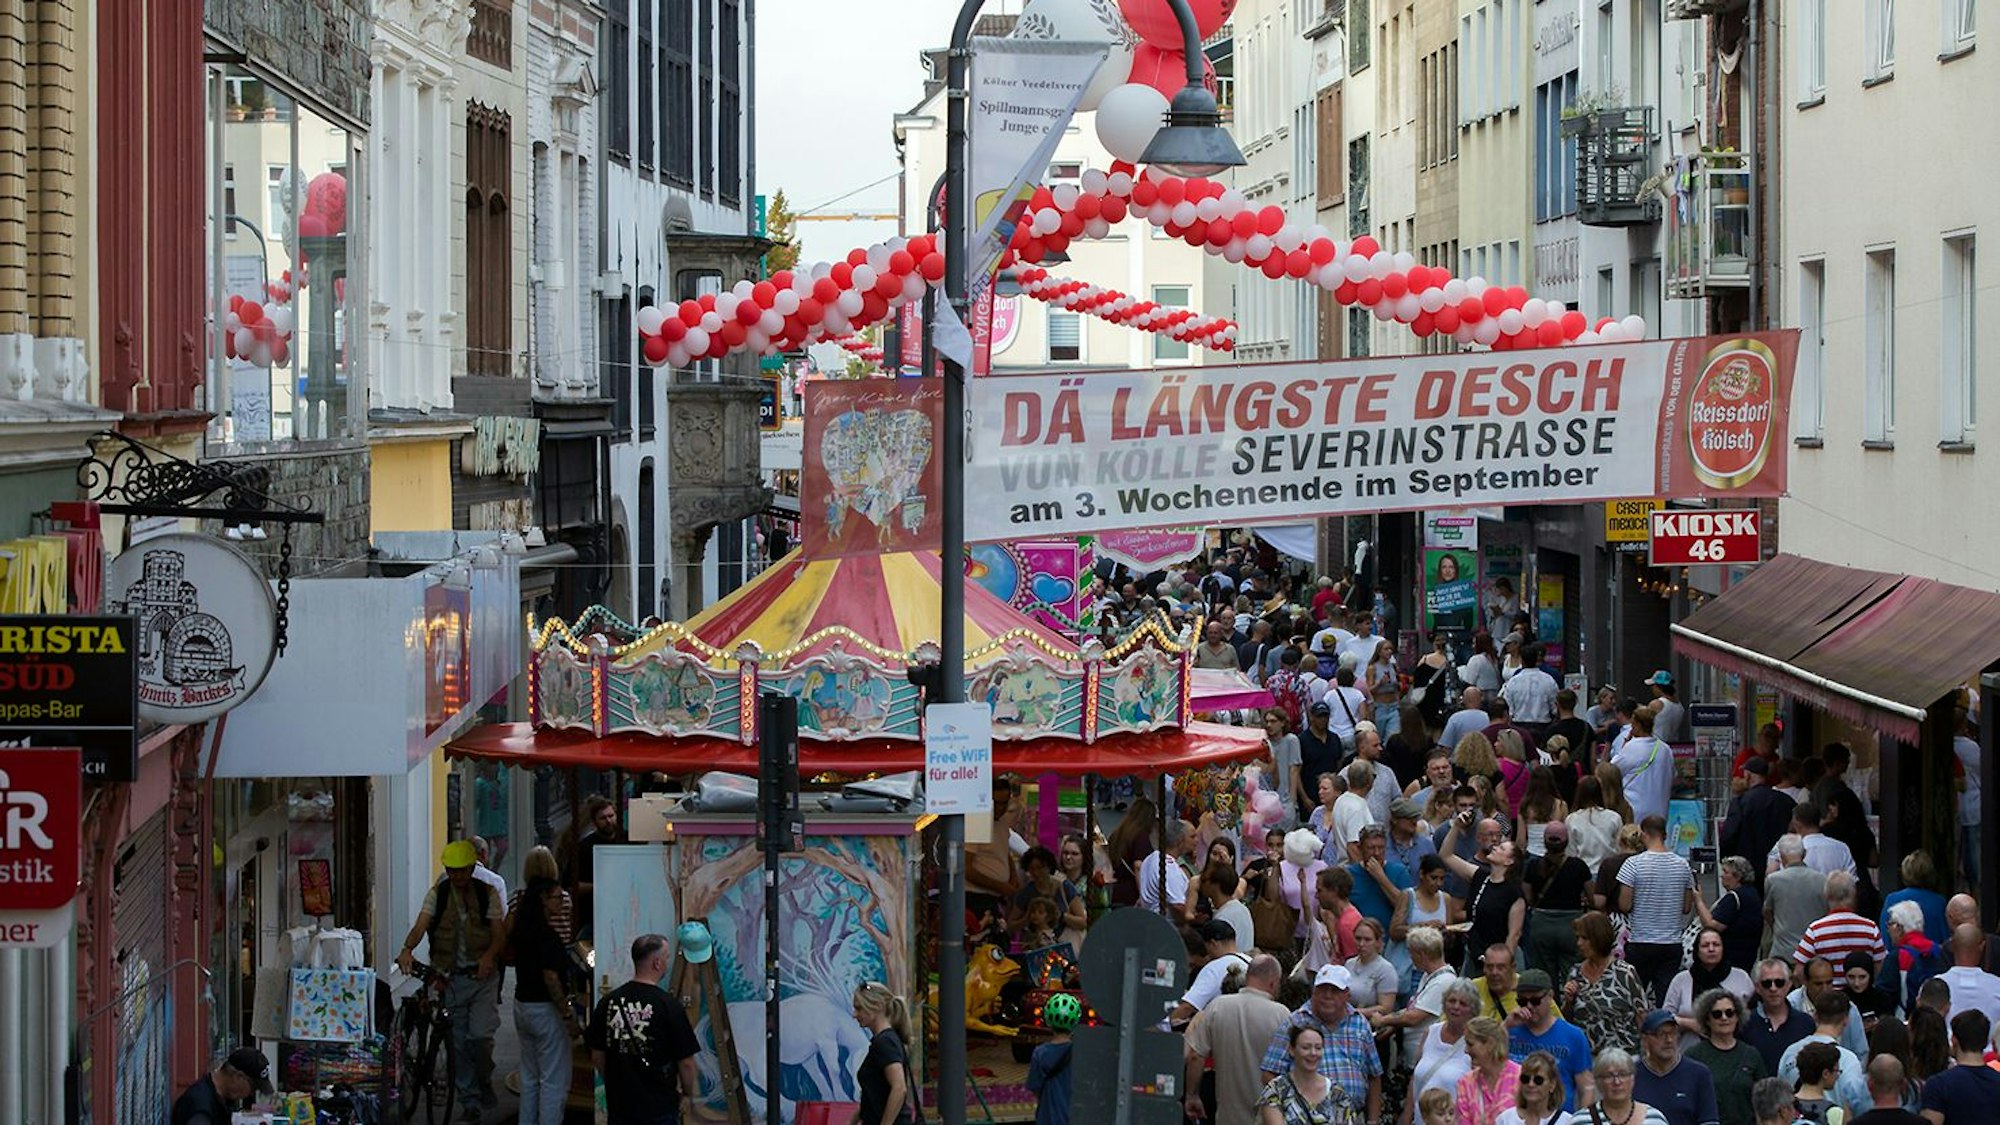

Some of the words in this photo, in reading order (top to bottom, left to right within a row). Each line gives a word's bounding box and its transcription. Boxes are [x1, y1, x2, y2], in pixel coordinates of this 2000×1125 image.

[983, 77, 1018, 87] Kölner
[1000, 119, 1039, 135] Junge
[1002, 378, 1085, 446] DÄ
[1111, 374, 1397, 441] LÄNGSTE
[1414, 357, 1626, 421] DESCH
[1693, 400, 1770, 423] Reissdorf
[1702, 428, 1755, 452] Kölsch
[1000, 453, 1079, 492] VUN
[1095, 441, 1219, 485] KÖLLE
[1232, 417, 1616, 475] SEVERINSTRASSE
[1010, 500, 1063, 524] am
[1075, 492, 1107, 518] 3.
[1118, 476, 1342, 514] Wochenende
[1356, 473, 1396, 498] im
[1408, 464, 1599, 498] September
[1654, 513, 1757, 537] KIOSK
[1689, 539, 1725, 561] 46
[0, 626, 126, 654] RISTA
[929, 751, 957, 764] Free
[960, 748, 989, 762] WiFi
[929, 767, 947, 781] für
[951, 766, 979, 780] alle!
